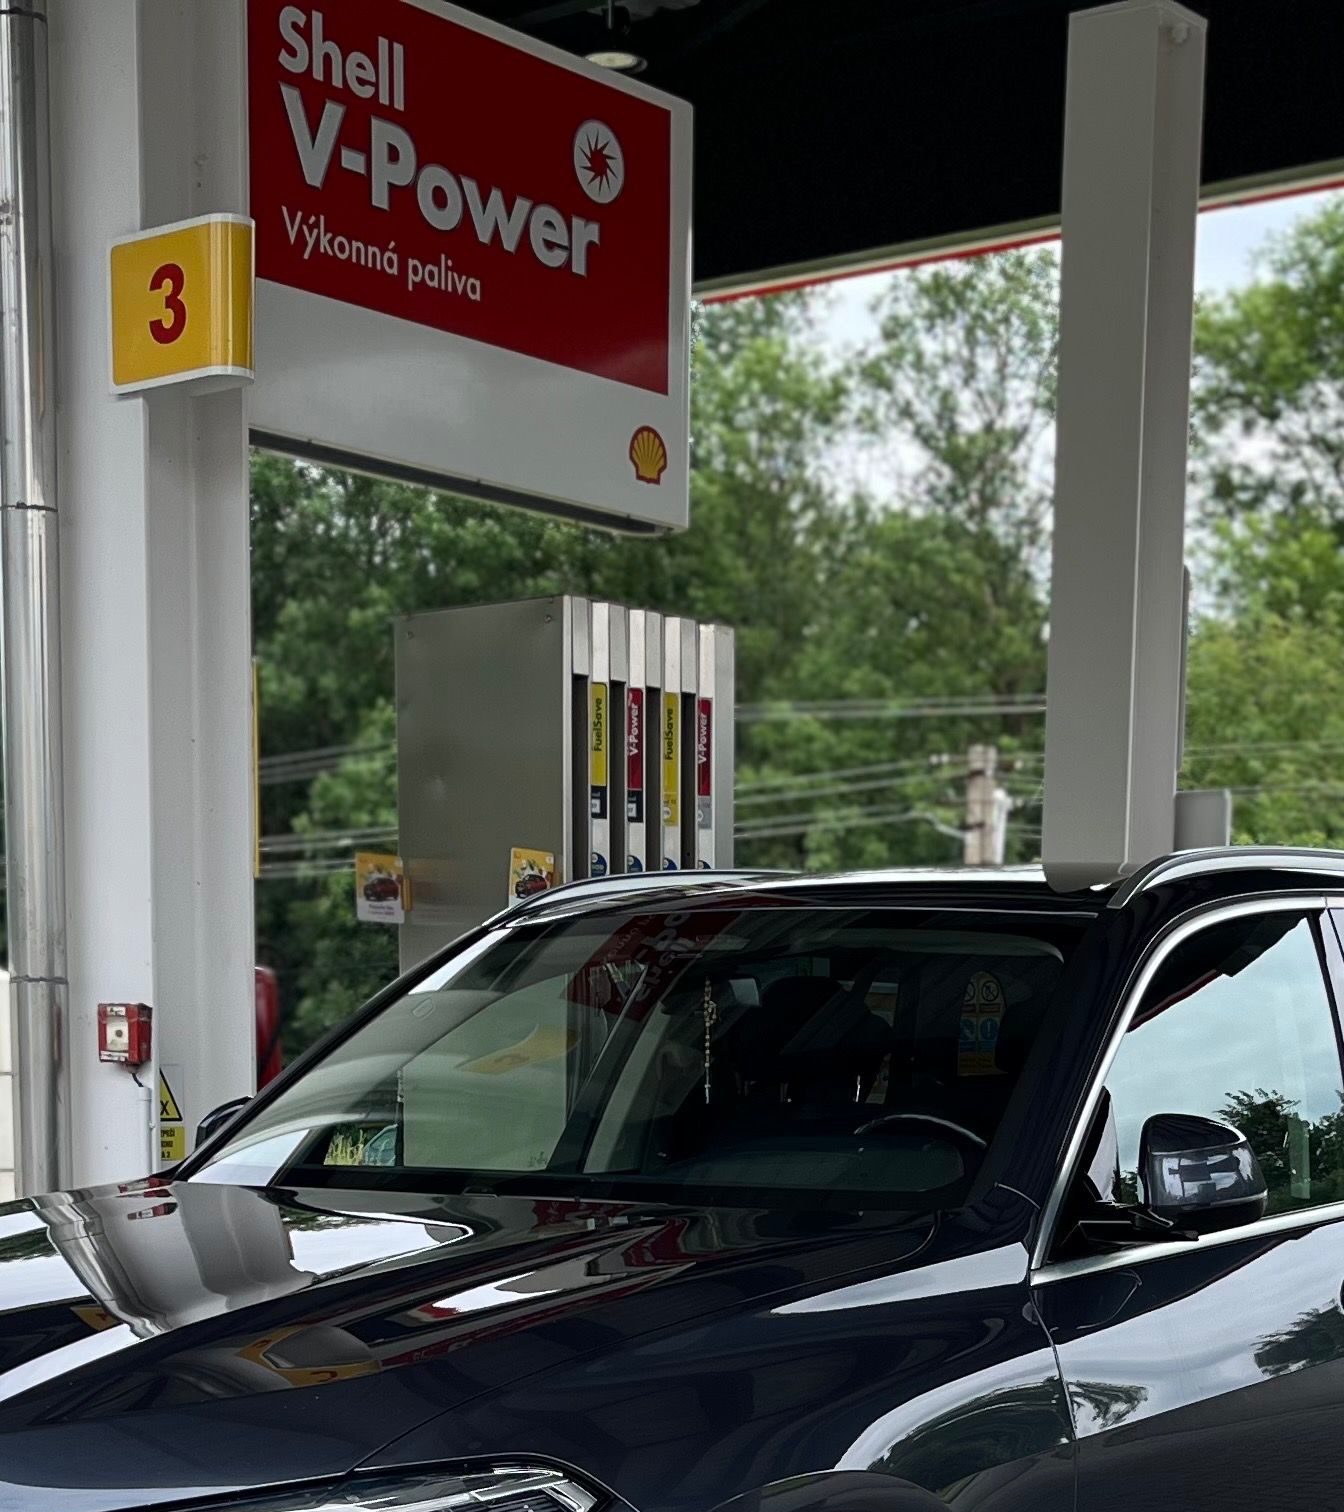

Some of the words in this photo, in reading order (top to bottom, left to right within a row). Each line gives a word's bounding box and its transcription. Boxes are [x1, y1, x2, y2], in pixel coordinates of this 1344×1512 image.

[278, 5, 405, 112] Shell
[279, 81, 601, 279] V-Power
[281, 205, 399, 276] Výkonná
[407, 253, 482, 302] paliva
[148, 262, 187, 345] 3
[593, 697, 603, 752] FuelSave
[629, 703, 640, 757] V-Power
[664, 708, 675, 761] FuelSave
[697, 712, 708, 765] V-Power
